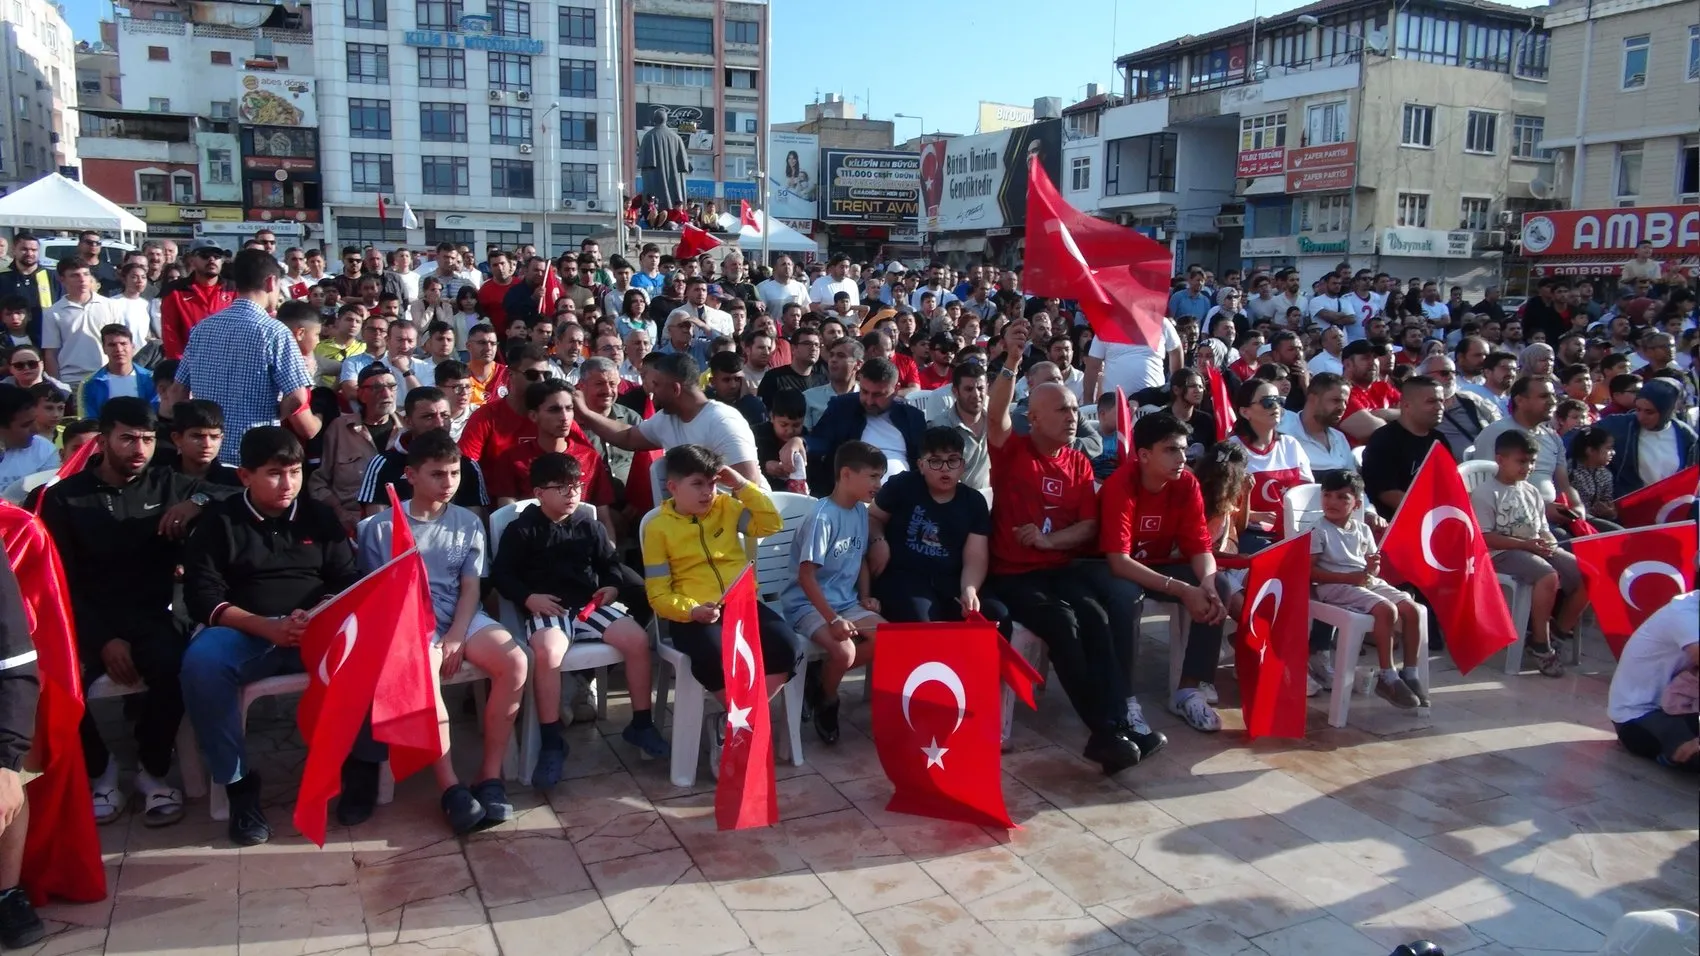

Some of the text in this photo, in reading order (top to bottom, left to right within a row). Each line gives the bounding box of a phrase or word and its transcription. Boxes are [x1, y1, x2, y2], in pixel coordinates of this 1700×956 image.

[1304, 148, 1348, 160] ZAFER PARTİSİ
[880, 160, 890, 168] EN
[891, 160, 919, 168] BÜYÜK
[947, 147, 997, 175] Bütün Ümidim
[841, 170, 873, 178] 111.000
[1303, 169, 1348, 181] ZAFER PARTİSİ
[950, 174, 993, 200] Gençliktedir
[832, 200, 919, 214] TRENT AVM
[1554, 266, 1613, 275] AMBAR
